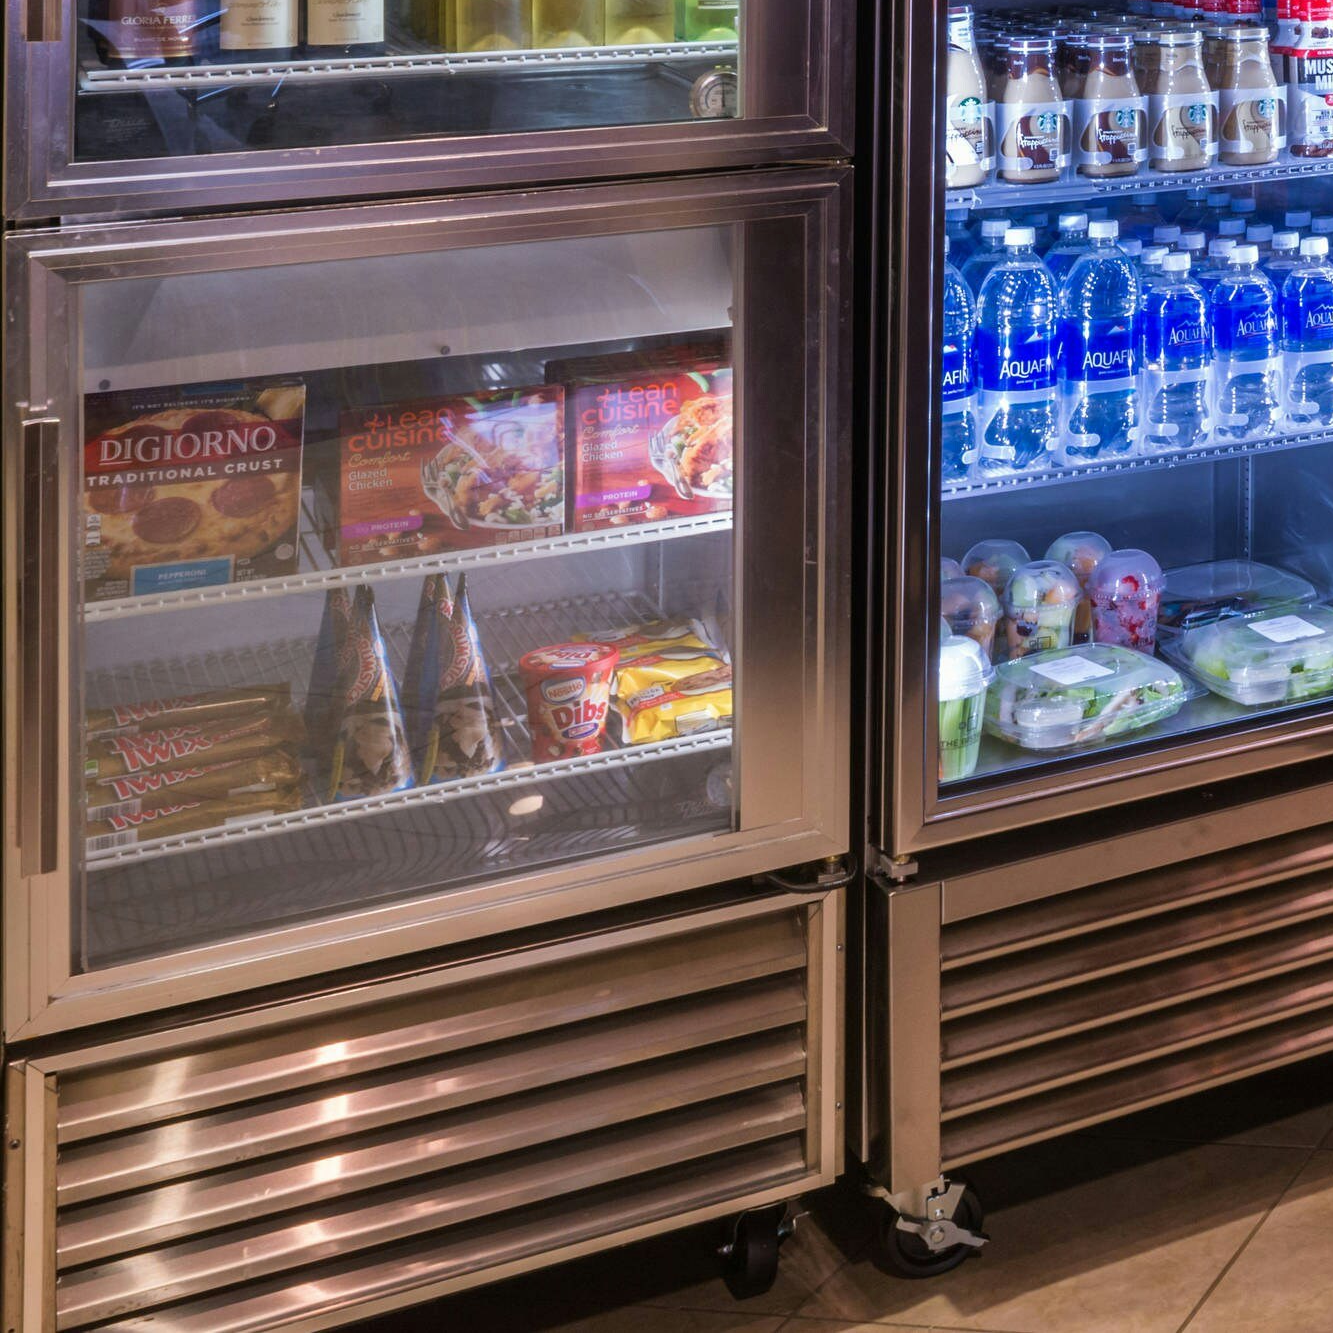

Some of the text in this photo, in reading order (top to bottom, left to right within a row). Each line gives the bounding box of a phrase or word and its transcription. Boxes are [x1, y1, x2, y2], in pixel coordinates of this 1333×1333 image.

[582, 440, 618, 453] Glazed
[582, 451, 624, 463] Chicken
[86, 458, 284, 488] TRADITIONAL CRUST
[348, 467, 388, 482] Glazed
[348, 478, 394, 492] Chicken
[602, 490, 638, 501] PROTEIN
[551, 698, 608, 731] Dibs
[111, 735, 213, 773] TWIX
